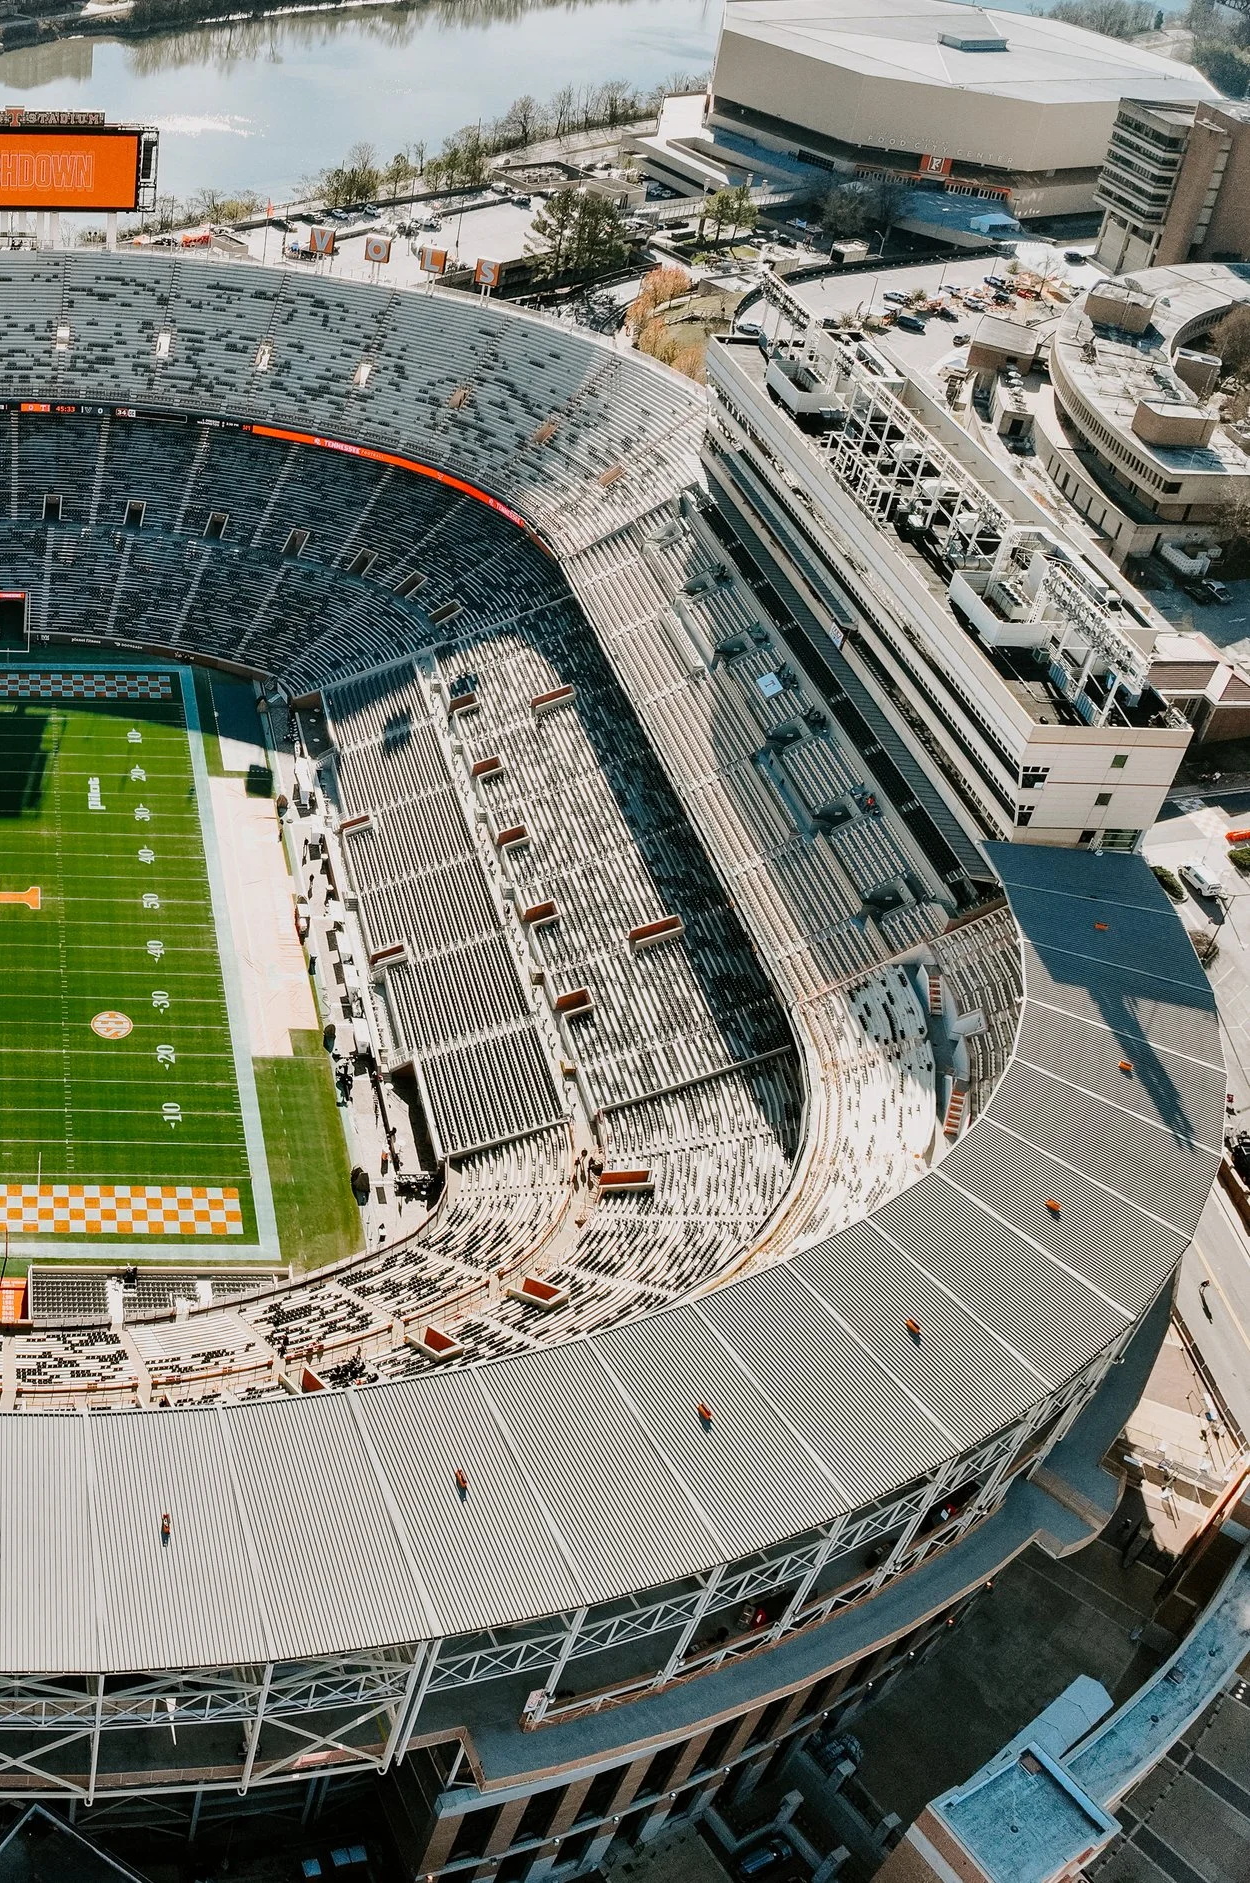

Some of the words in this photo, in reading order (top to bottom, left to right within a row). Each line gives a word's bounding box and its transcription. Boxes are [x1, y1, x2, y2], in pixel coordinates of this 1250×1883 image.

[5, 107, 25, 127] T
[26, 111, 100, 125] STADIUM
[868, 135, 907, 147] FOOD
[914, 141, 948, 153] CITY
[956, 149, 1014, 164] CENTER
[324, 439, 361, 455] TENNESSEE
[127, 731, 142, 743] 10
[130, 768, 146, 782] 20
[134, 807, 150, 822] 30
[138, 849, 155, 864] 40
[142, 893, 160, 910] 50
[146, 940, 165, 958] 40
[151, 990, 170, 1009] 30
[156, 1044, 176, 1064] 20
[161, 1102, 183, 1122] 10
